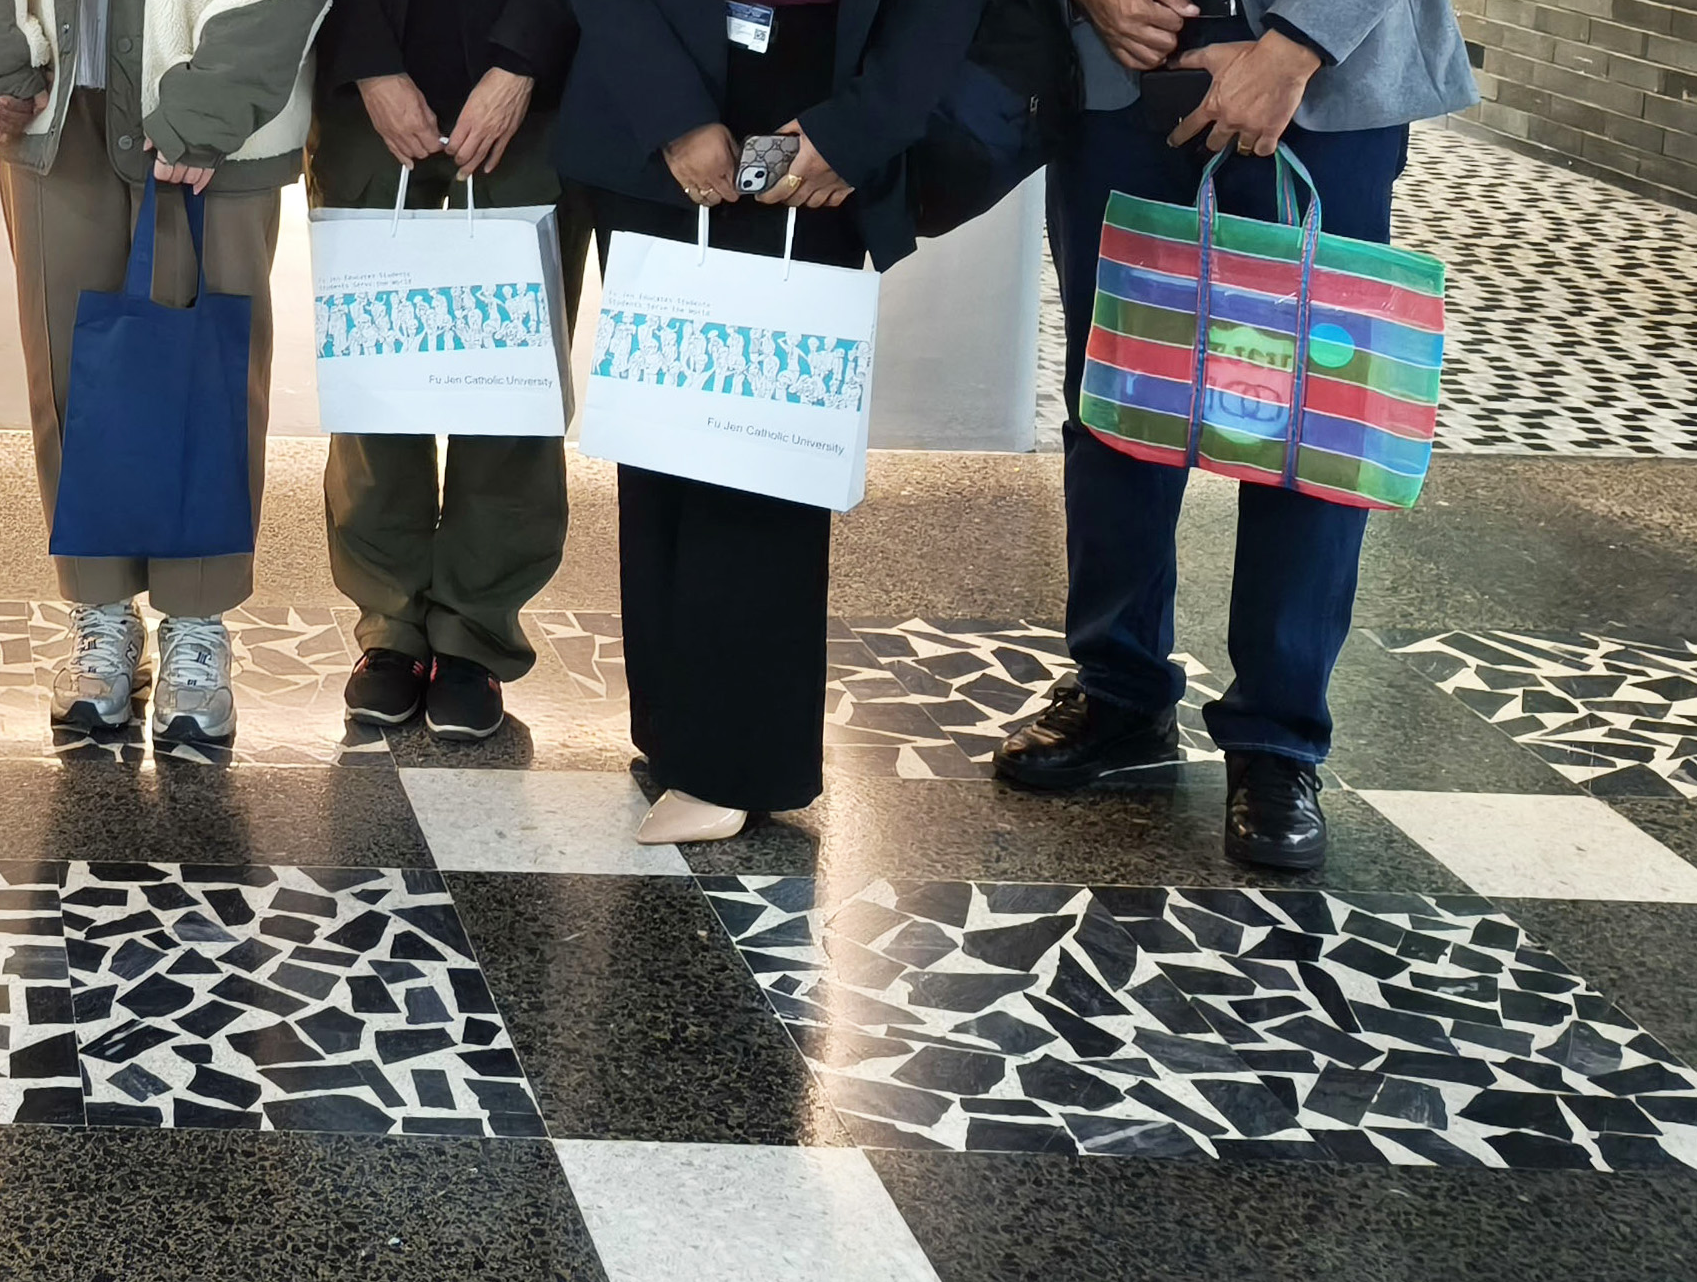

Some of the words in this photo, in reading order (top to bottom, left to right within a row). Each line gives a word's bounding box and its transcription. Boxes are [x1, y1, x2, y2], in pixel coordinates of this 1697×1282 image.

[428, 374, 441, 385] Fu
[444, 375, 462, 385] Jen
[464, 374, 504, 385] Catholic
[506, 375, 554, 388] University
[707, 417, 721, 429] Fu
[723, 421, 743, 433] Jen
[745, 425, 790, 443] Catholic
[791, 434, 845, 456] University
